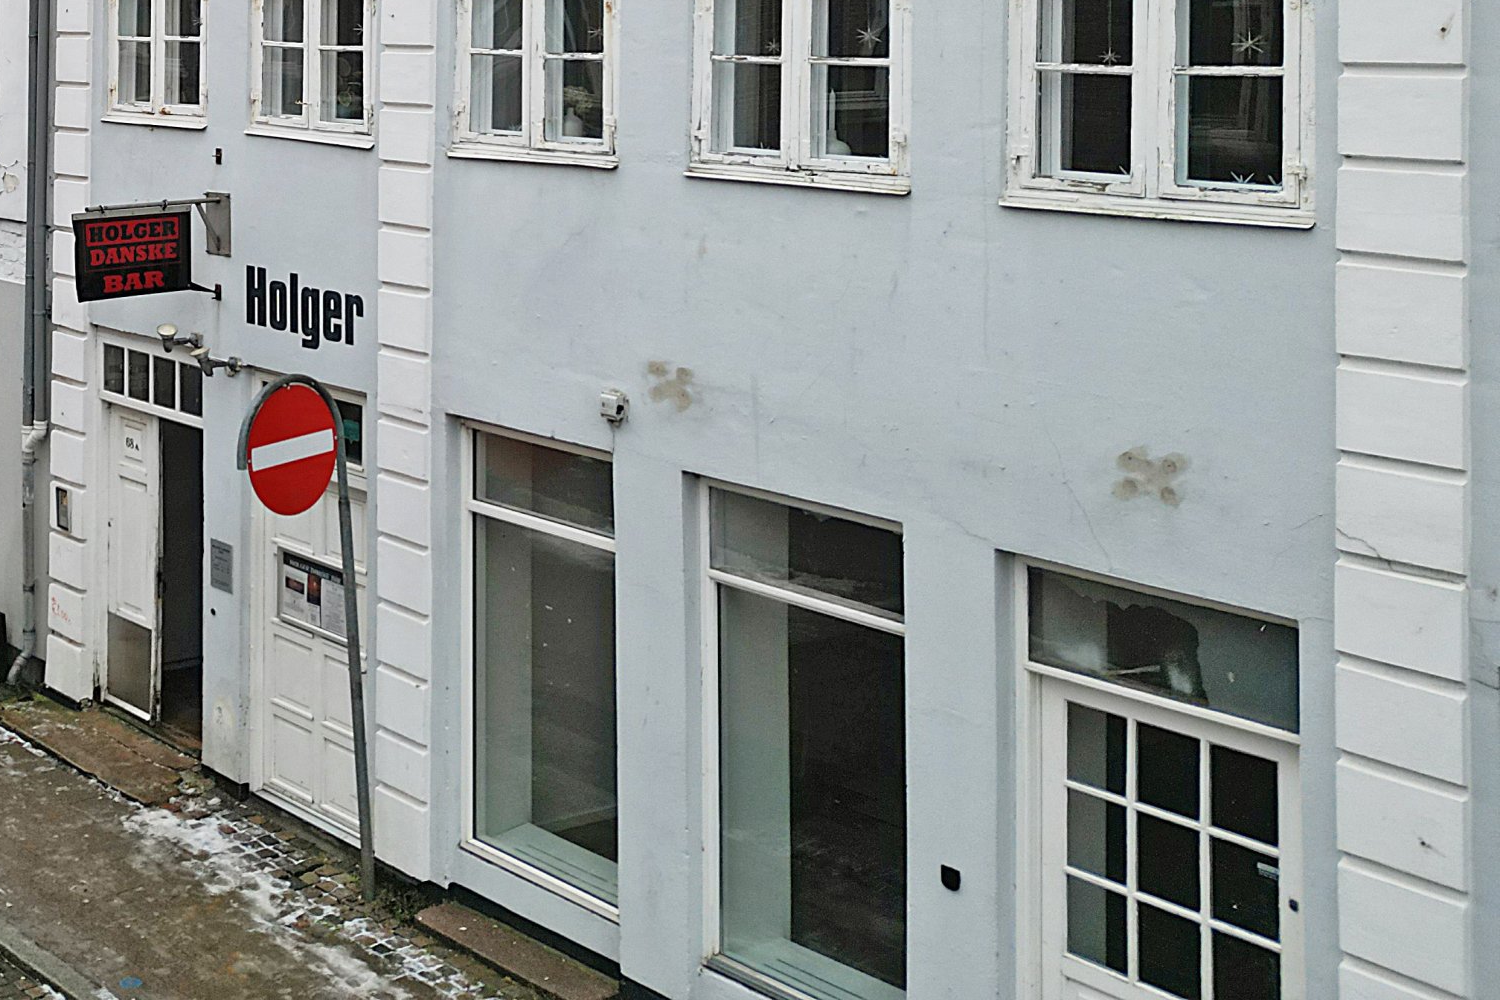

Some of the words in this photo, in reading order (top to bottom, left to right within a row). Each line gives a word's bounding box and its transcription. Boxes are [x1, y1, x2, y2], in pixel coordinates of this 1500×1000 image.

[89, 221, 176, 242] HOLGER
[90, 242, 177, 266] DANSKE
[103, 270, 165, 293] BAR
[246, 264, 364, 350] Holger
